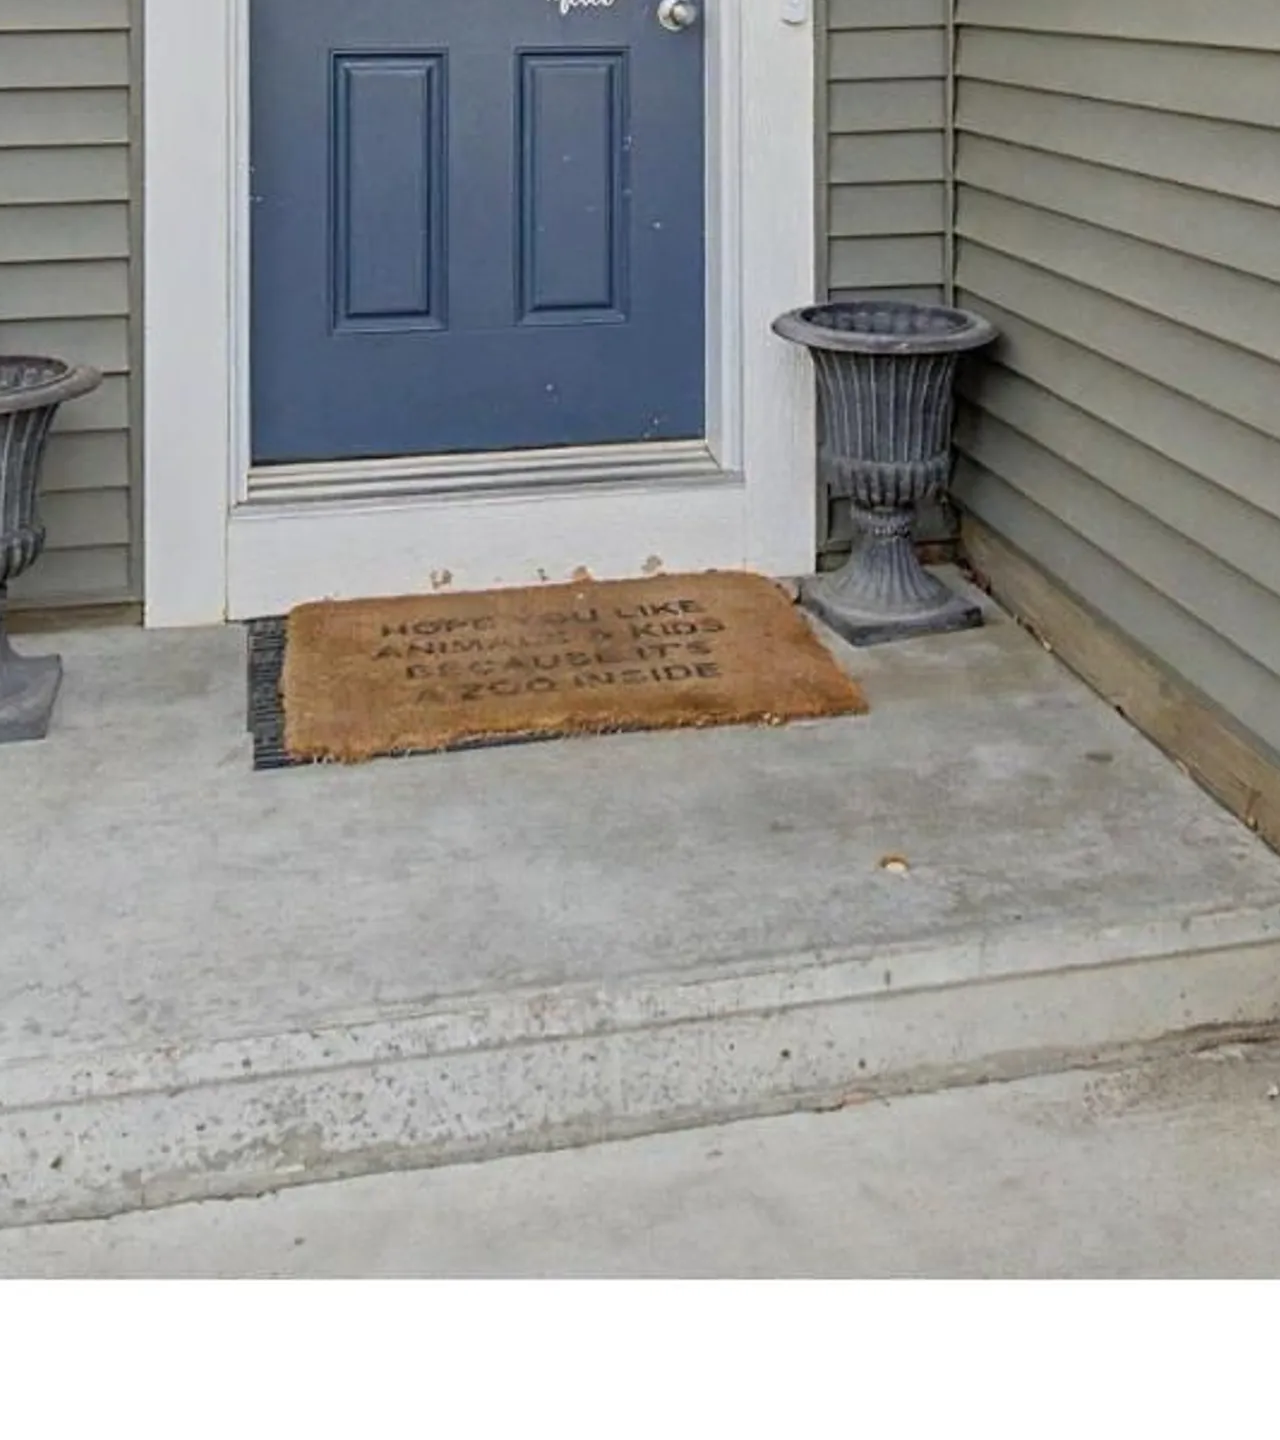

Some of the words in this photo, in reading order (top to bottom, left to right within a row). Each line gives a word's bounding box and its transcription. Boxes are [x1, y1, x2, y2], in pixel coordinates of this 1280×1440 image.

[381, 616, 496, 637] HOPE
[614, 599, 704, 619] LIKE
[631, 617, 726, 638] KIDS
[460, 677, 556, 701] ZOO
[573, 662, 722, 688] INSIDE
